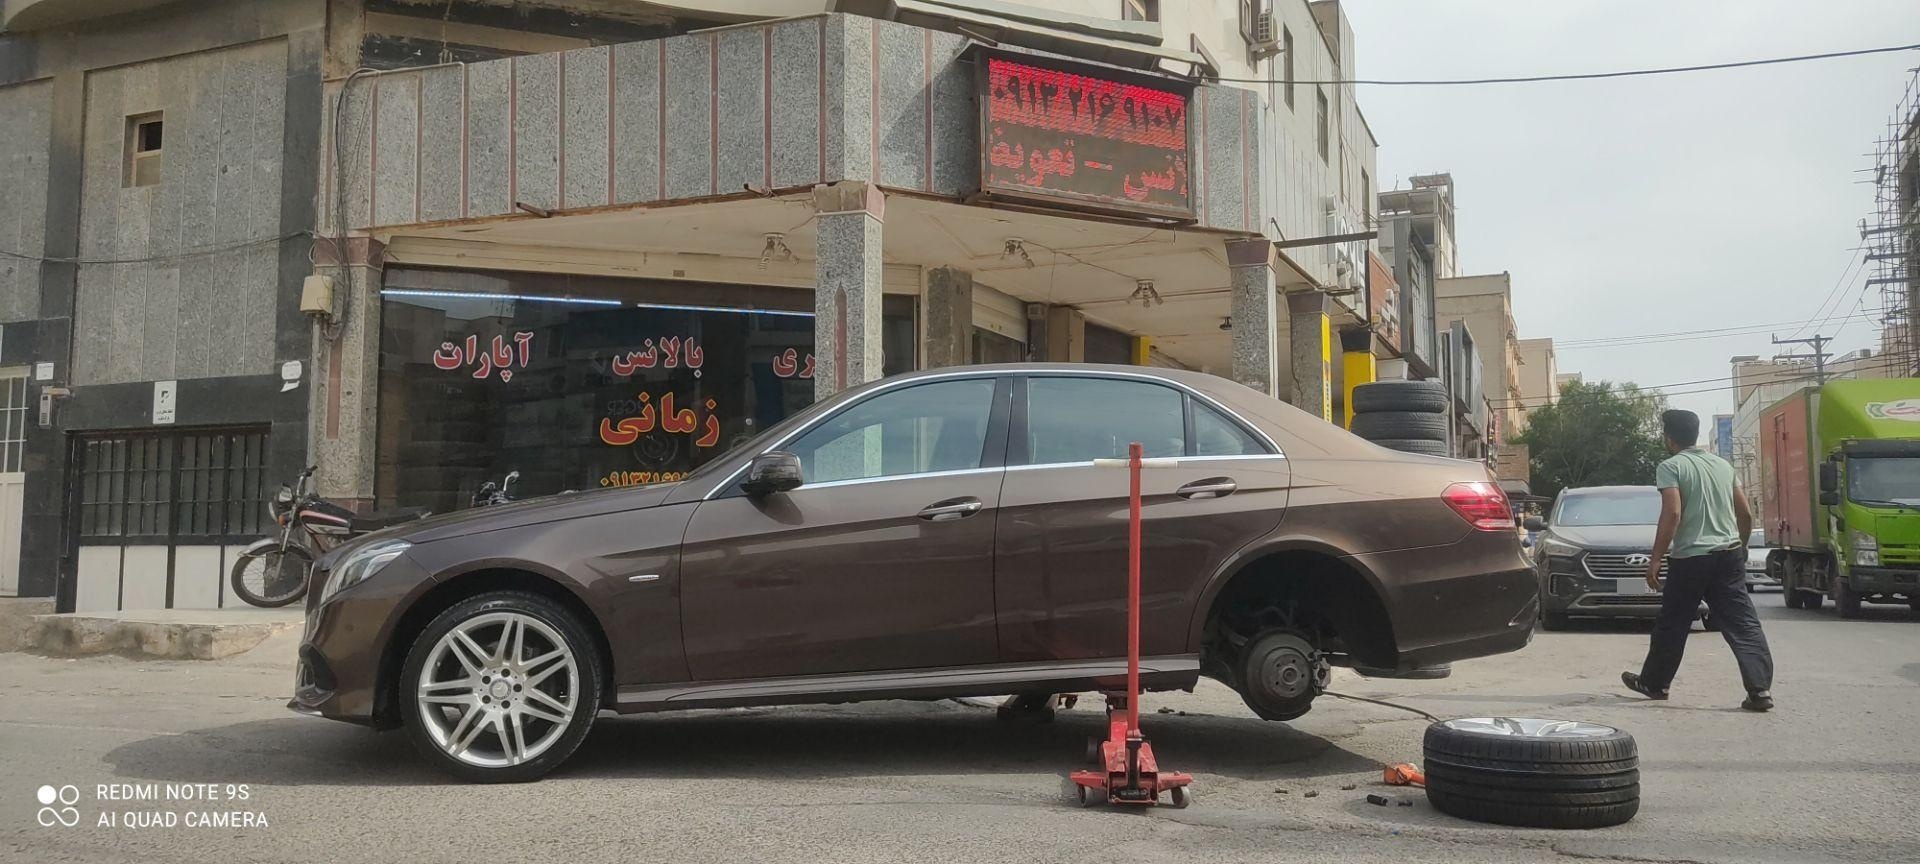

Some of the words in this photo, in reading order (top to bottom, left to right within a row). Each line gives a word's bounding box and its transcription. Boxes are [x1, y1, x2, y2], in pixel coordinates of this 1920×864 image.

[433, 331, 534, 382] آپارات
[612, 335, 704, 378] بالانس
[772, 347, 815, 378] ری
[599, 391, 720, 447] زمانی
